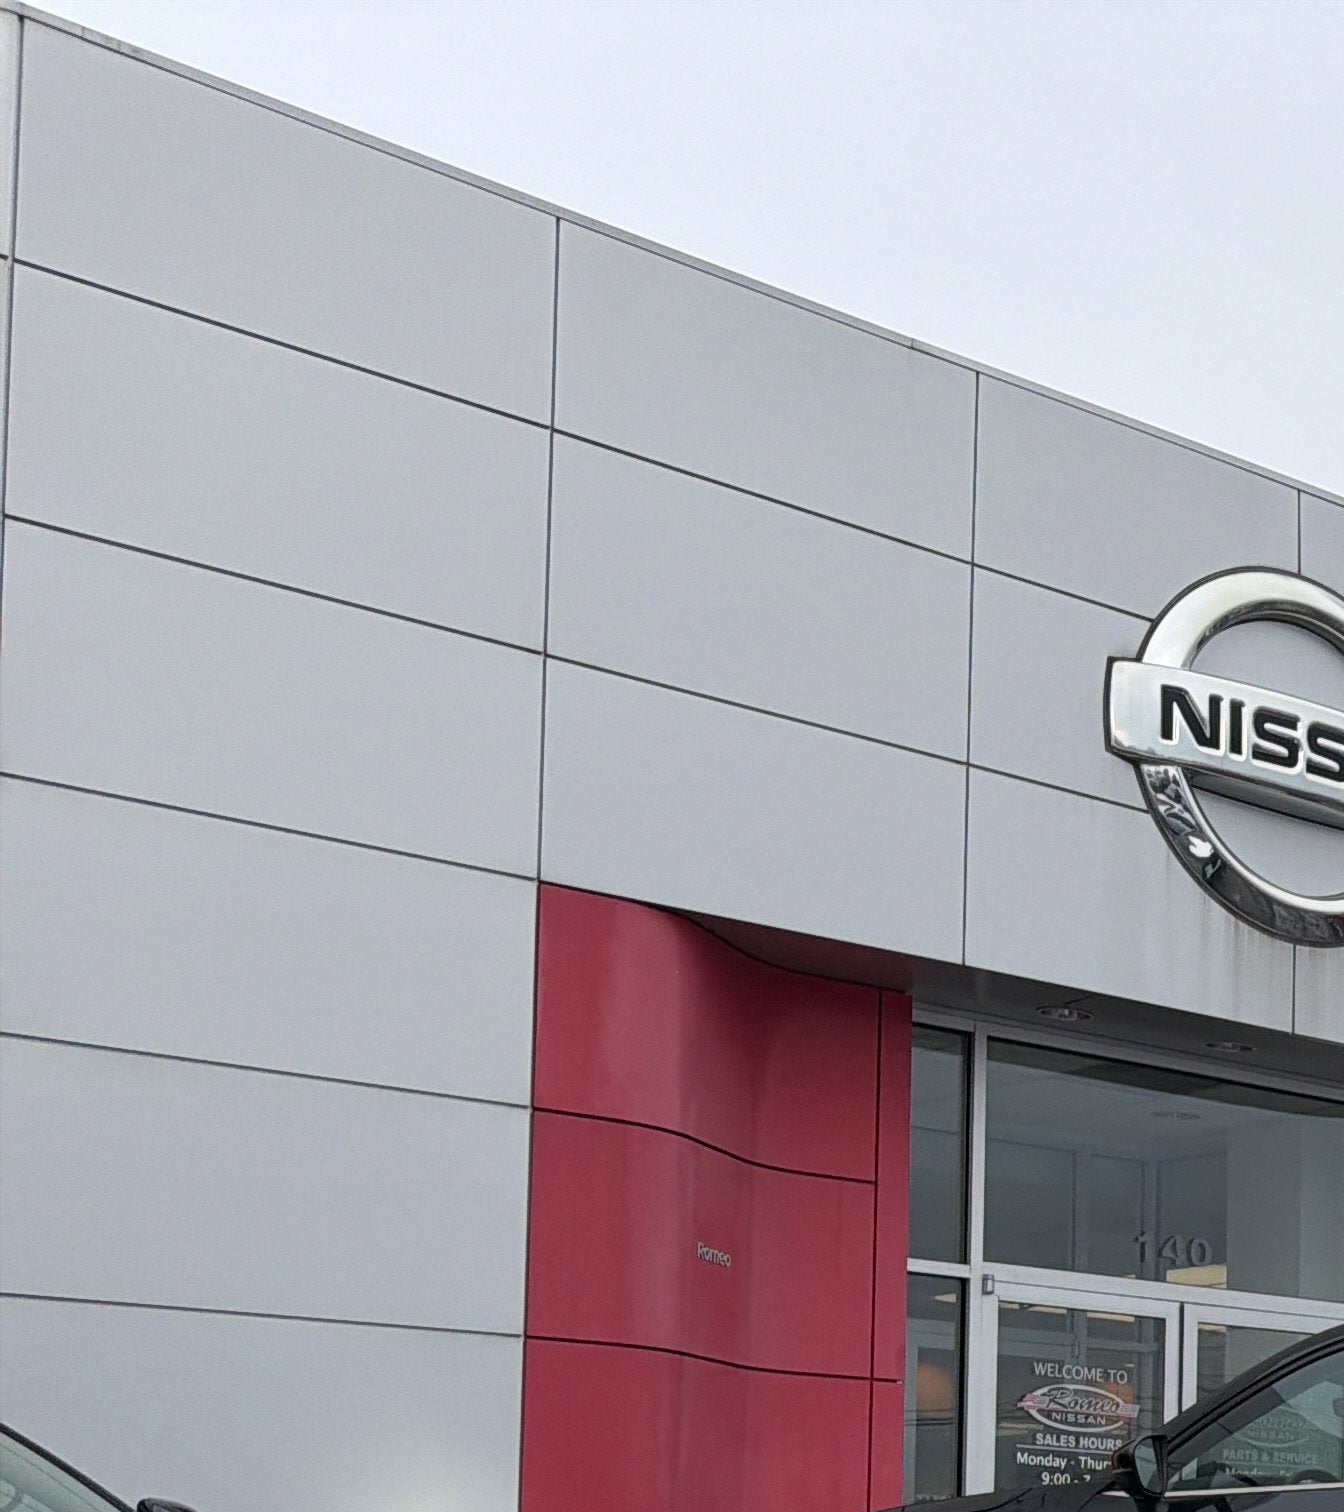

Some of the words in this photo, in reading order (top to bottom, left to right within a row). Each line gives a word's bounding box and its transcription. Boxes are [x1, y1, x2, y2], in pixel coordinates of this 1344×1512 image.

[697, 1241, 733, 1268] Romeo
[1133, 1230, 1212, 1268] 140
[1033, 1361, 1104, 1383] WELCOME
[1107, 1369, 1128, 1384] TO
[1042, 1387, 1121, 1413] Romeo
[1051, 1411, 1106, 1425] NISSAN
[1035, 1433, 1076, 1448] SALES
[1079, 1436, 1123, 1451] HOURS
[1016, 1452, 1068, 1470] Monday
[1078, 1456, 1112, 1471] Thur
[1222, 1448, 1258, 1462] PARTS
[1261, 1451, 1271, 1463] &
[1273, 1452, 1319, 1465] SERVICE
[1041, 1472, 1071, 1486] 9:00
